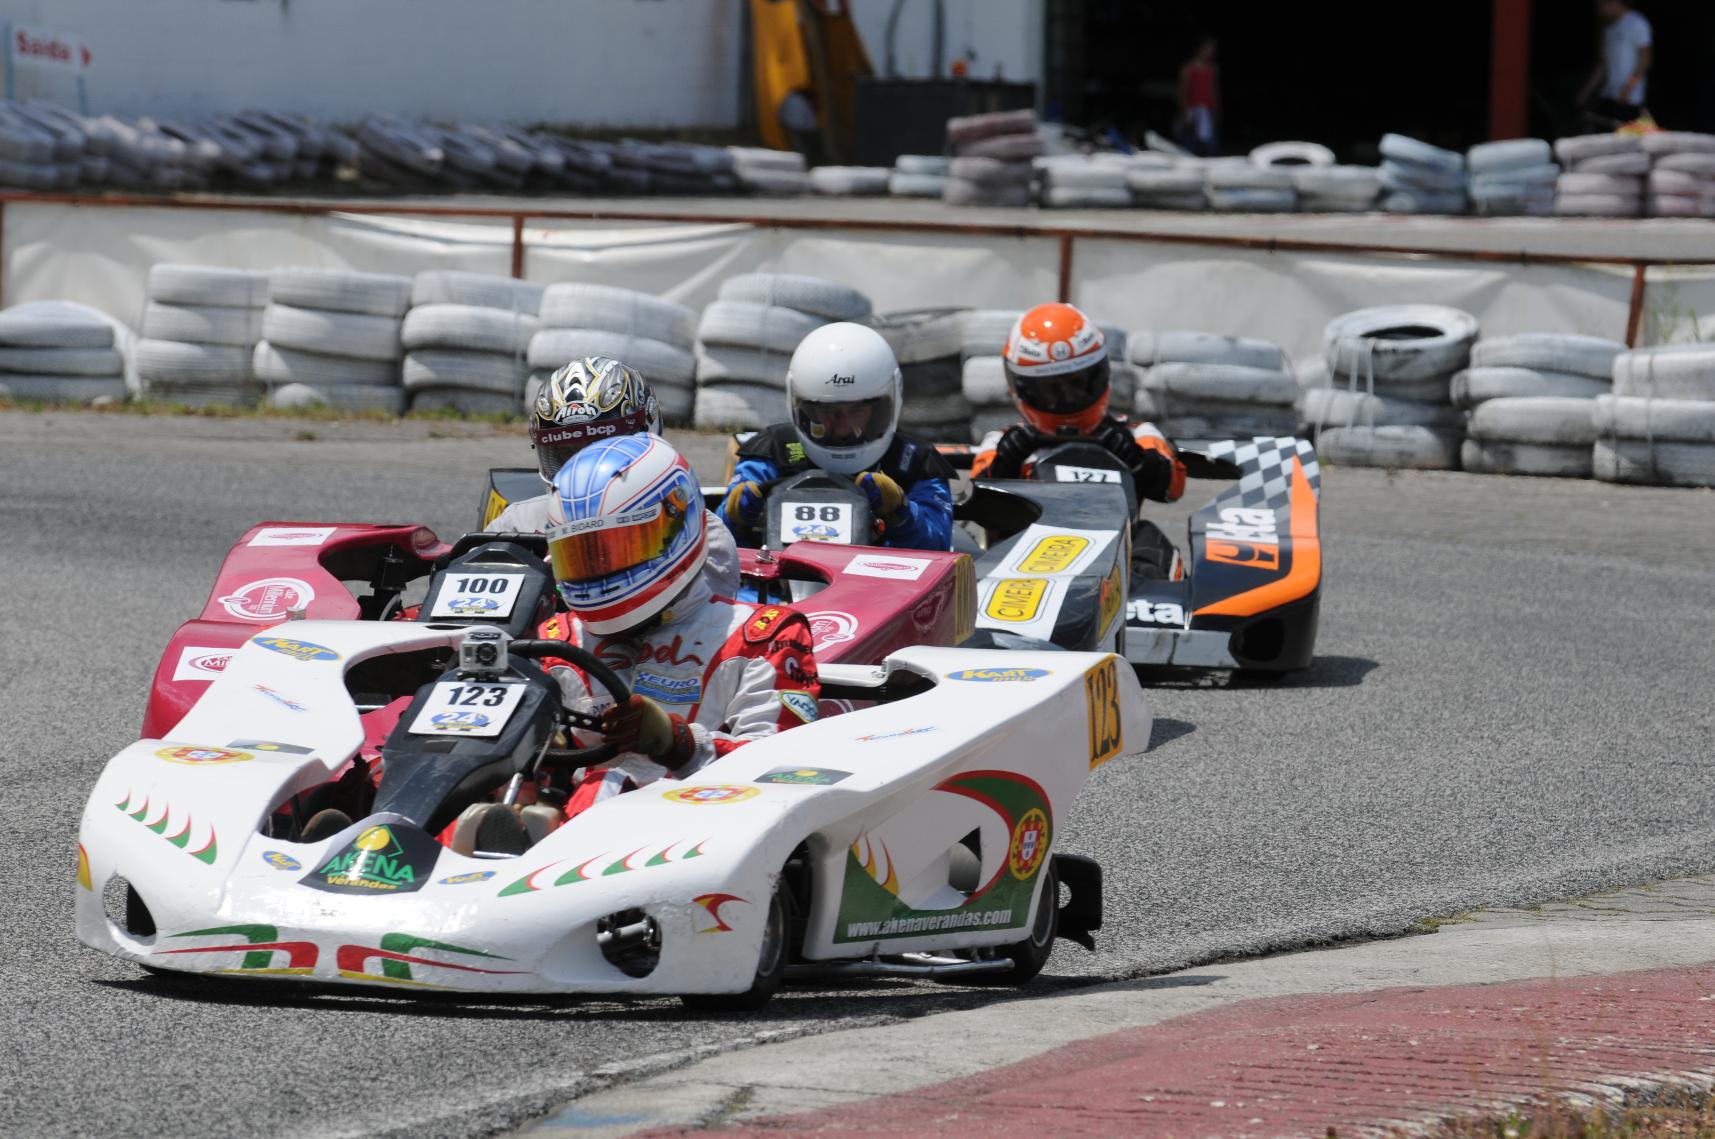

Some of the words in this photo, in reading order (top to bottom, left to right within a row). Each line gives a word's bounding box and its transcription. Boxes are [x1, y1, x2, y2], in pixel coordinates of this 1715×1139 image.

[825, 374, 855, 384] Arai
[555, 405, 597, 418] Airoh
[541, 430, 583, 443] clube
[586, 425, 616, 436] bcp
[795, 506, 840, 521] 88
[1028, 540, 1076, 572] CIMEIRA
[457, 578, 509, 594] 100
[593, 634, 704, 671] Sodi
[648, 675, 698, 689] EURO
[448, 686, 507, 706] 123
[1088, 661, 1121, 760] 123
[320, 851, 415, 883] AKENA
[847, 909, 1012, 938] www.akenaverandas.com
